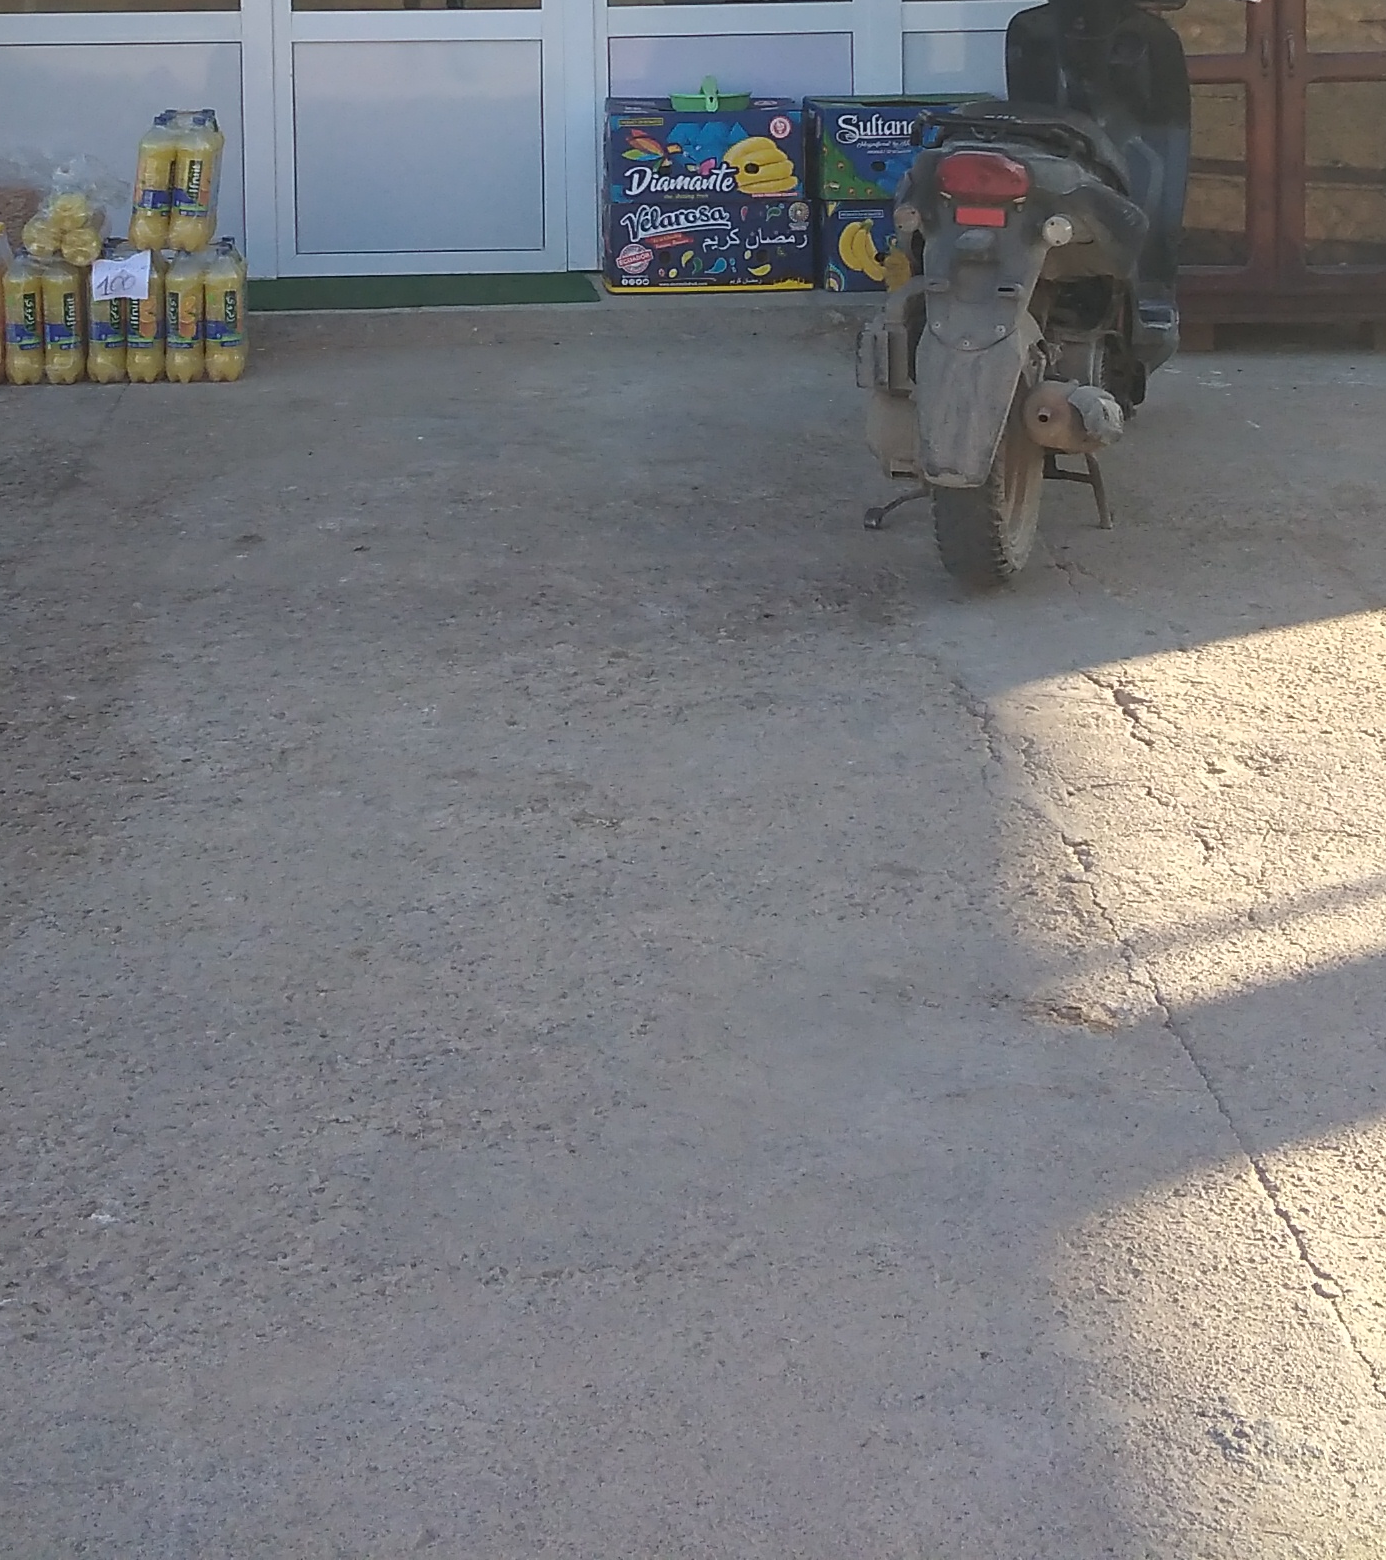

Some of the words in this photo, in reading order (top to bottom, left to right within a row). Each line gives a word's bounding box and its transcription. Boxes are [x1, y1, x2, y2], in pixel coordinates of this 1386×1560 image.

[624, 162, 736, 196] Diamante
[702, 228, 740, 252] كريم
[745, 229, 808, 249] رمضان
[618, 251, 652, 267] ECUADOR
[97, 271, 136, 296] 100
